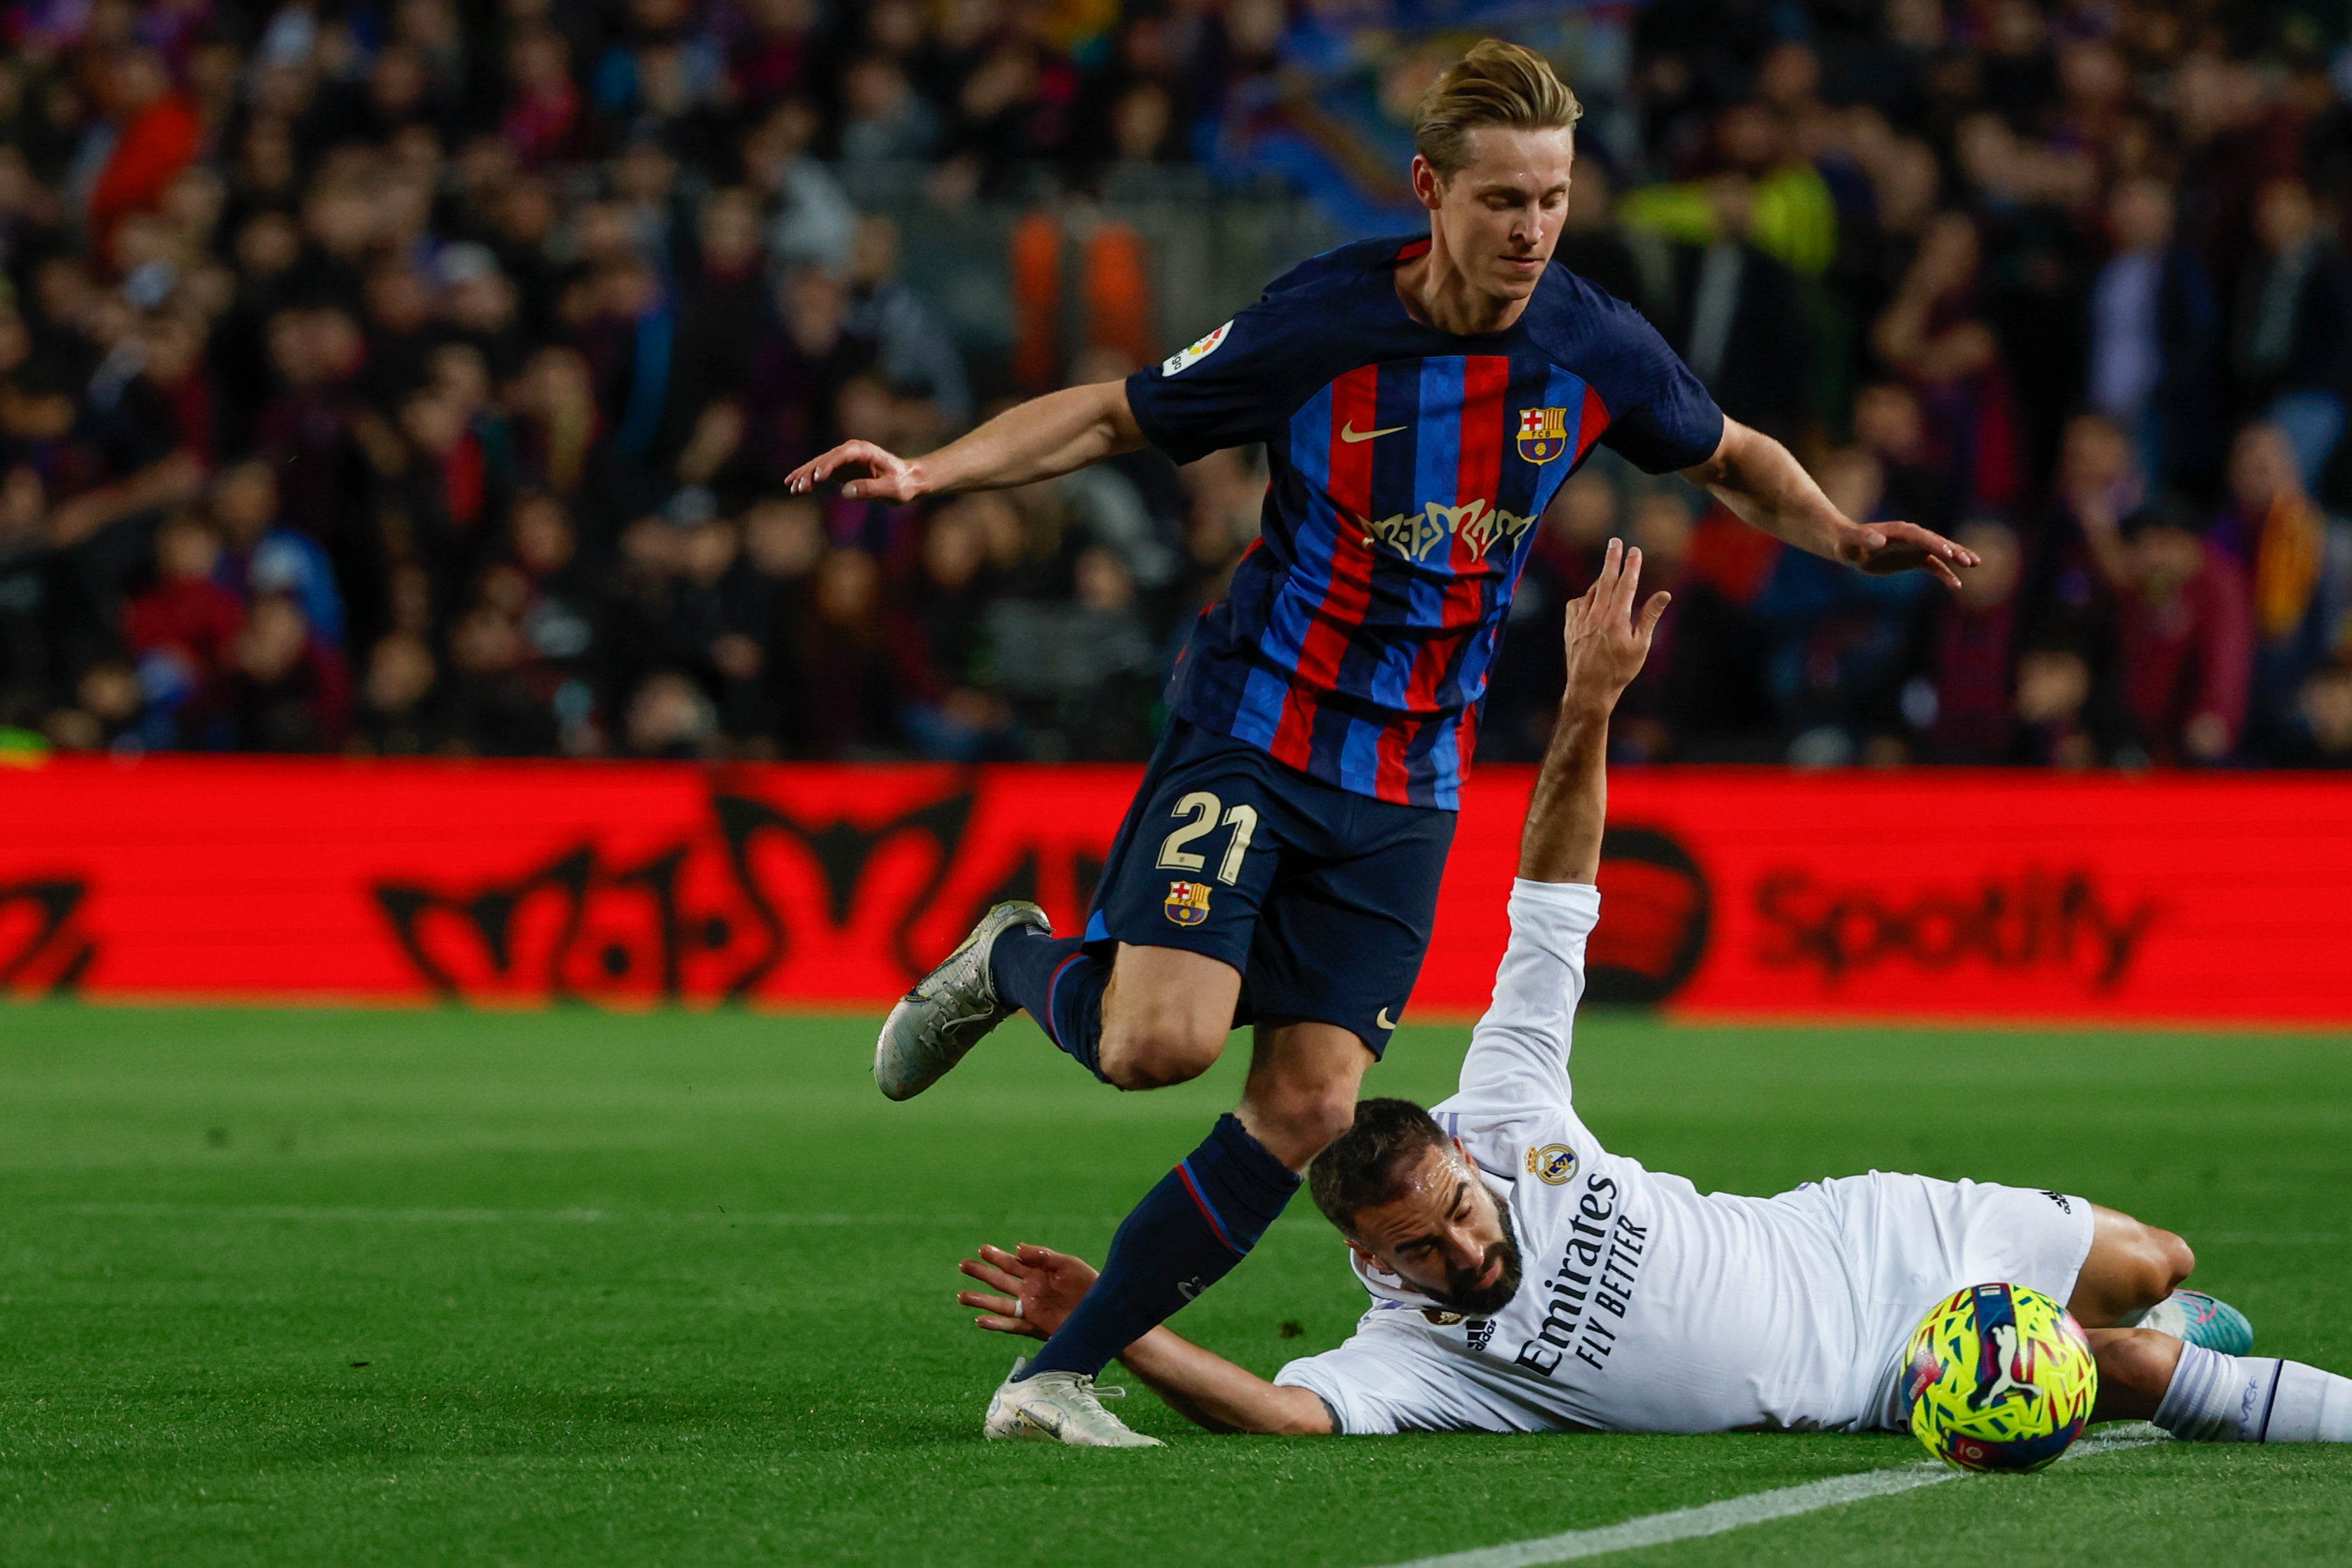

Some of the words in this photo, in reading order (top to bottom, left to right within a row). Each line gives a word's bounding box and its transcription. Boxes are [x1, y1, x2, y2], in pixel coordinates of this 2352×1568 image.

[1531, 431, 1551, 439] FCB
[1155, 790, 1259, 886] 21
[1753, 864, 2163, 996] Spotify
[1513, 1172, 1618, 1378] Emirates
[1594, 1214, 1648, 1320] BETTER
[1473, 1318, 1498, 1352] didas
[1575, 1316, 1617, 1371] FLY
